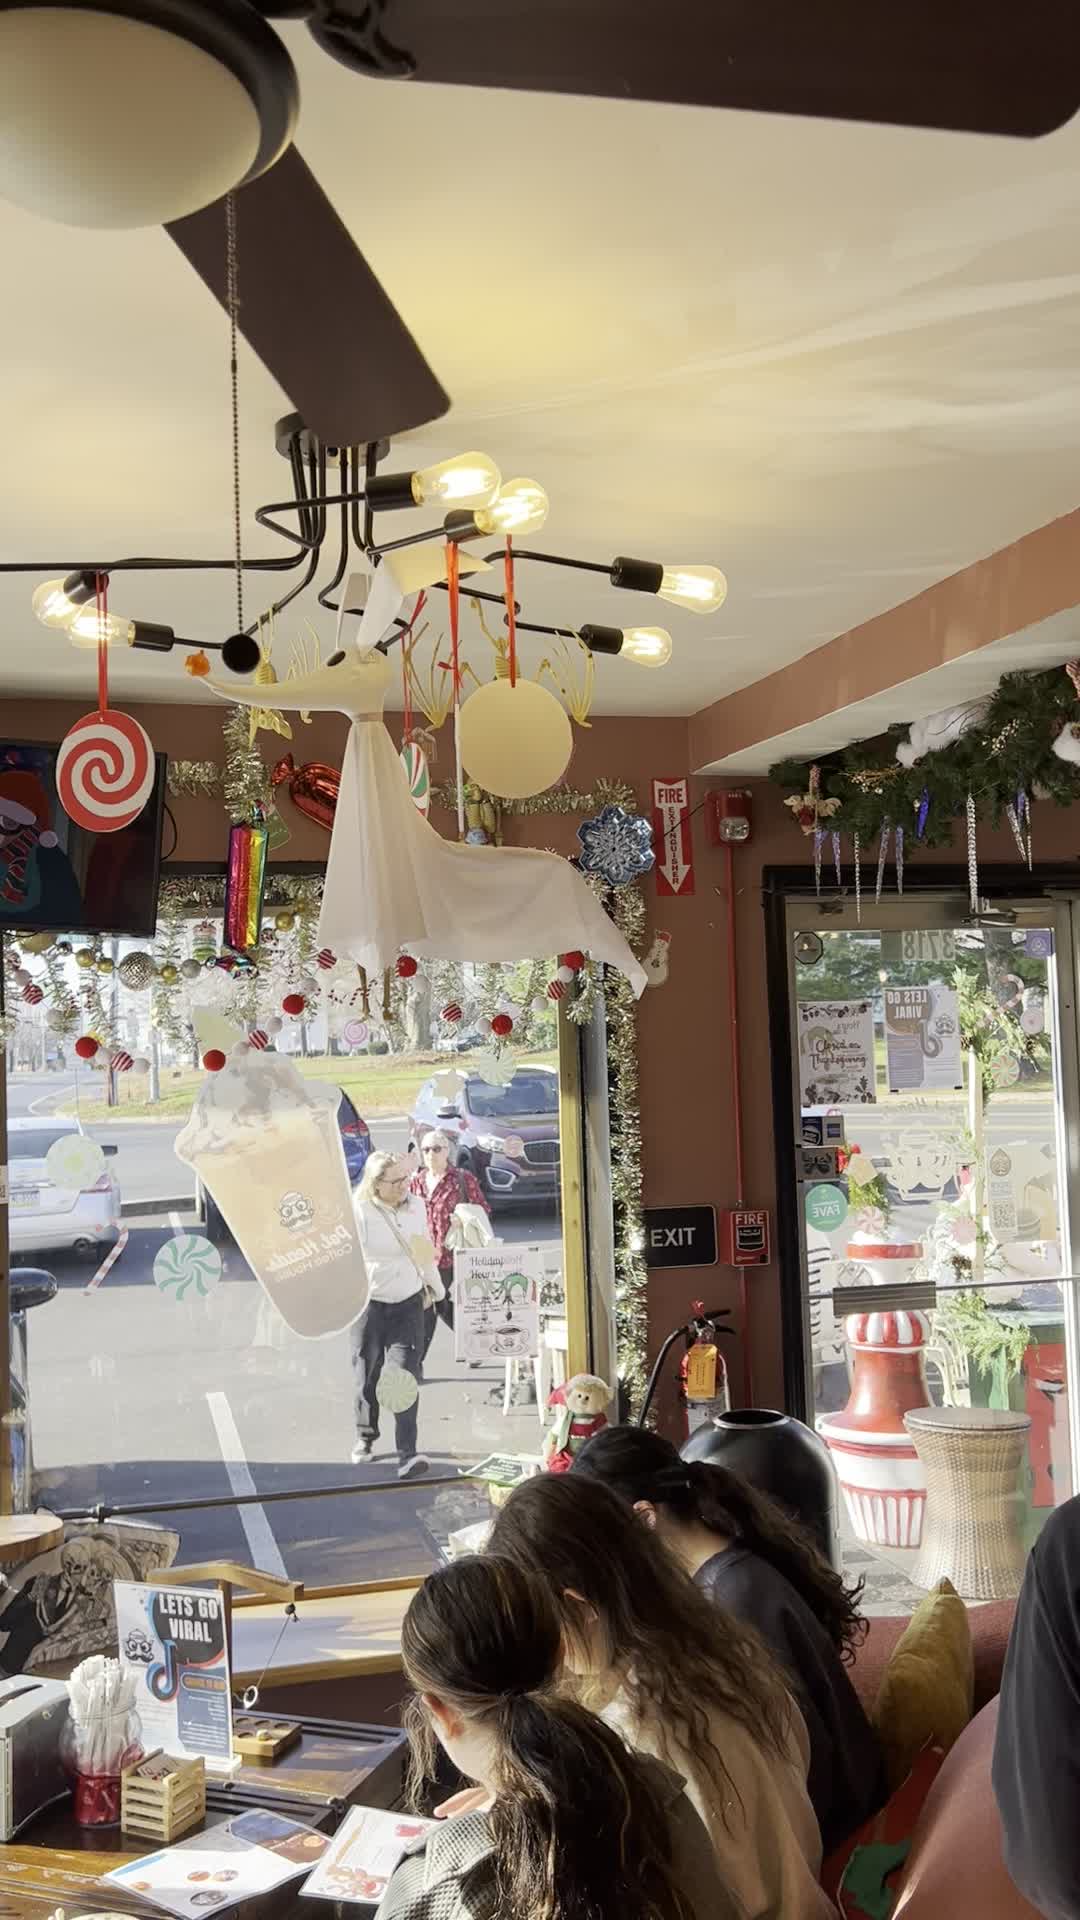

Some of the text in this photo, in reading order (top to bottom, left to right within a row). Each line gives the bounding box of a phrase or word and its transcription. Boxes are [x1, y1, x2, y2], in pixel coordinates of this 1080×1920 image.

[658, 788, 683, 803] FIRE
[668, 806, 679, 885] EXTINGUISHER
[735, 1213, 764, 1225] FIRE
[650, 1227, 696, 1248] EXIT
[472, 1256, 504, 1268] Holiday
[159, 1593, 219, 1619] LETS GO
[169, 1618, 212, 1643] VIRAL
